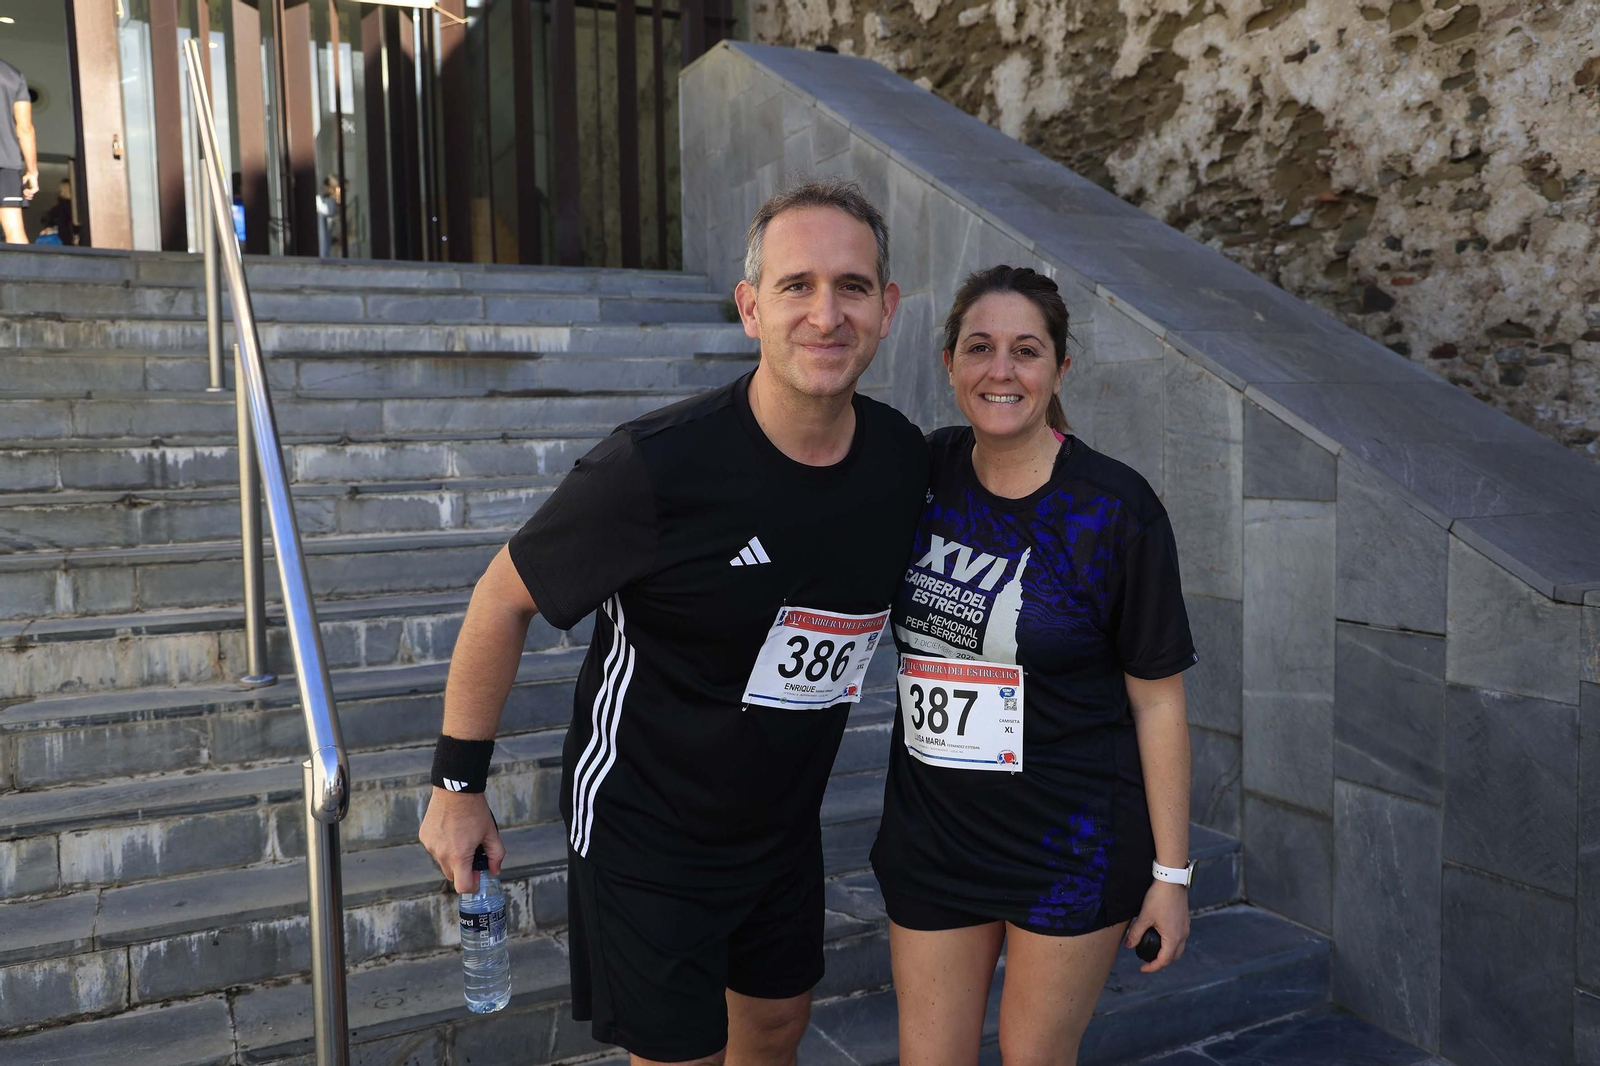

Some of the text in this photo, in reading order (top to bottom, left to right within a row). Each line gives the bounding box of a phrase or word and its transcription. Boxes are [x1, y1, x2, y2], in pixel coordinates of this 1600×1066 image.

[915, 534, 1009, 591] XVI
[905, 569, 987, 610] CARRERA DEL
[911, 588, 984, 624] ESTRECHO
[802, 615, 842, 629] CARRERA
[842, 621, 856, 630] DEL
[905, 616, 978, 649] PEPE SERRANO
[926, 613, 978, 639] MEMORIAL
[914, 637, 919, 645] 7
[777, 635, 856, 683] 386
[913, 662, 947, 675] CARRERA
[947, 667, 965, 676] DEL
[966, 668, 1018, 680] ESTRECHO
[784, 682, 816, 693] ENRIQUE
[909, 683, 979, 737] 387
[925, 736, 946, 747] MARIA
[1004, 726, 1015, 734] XL
